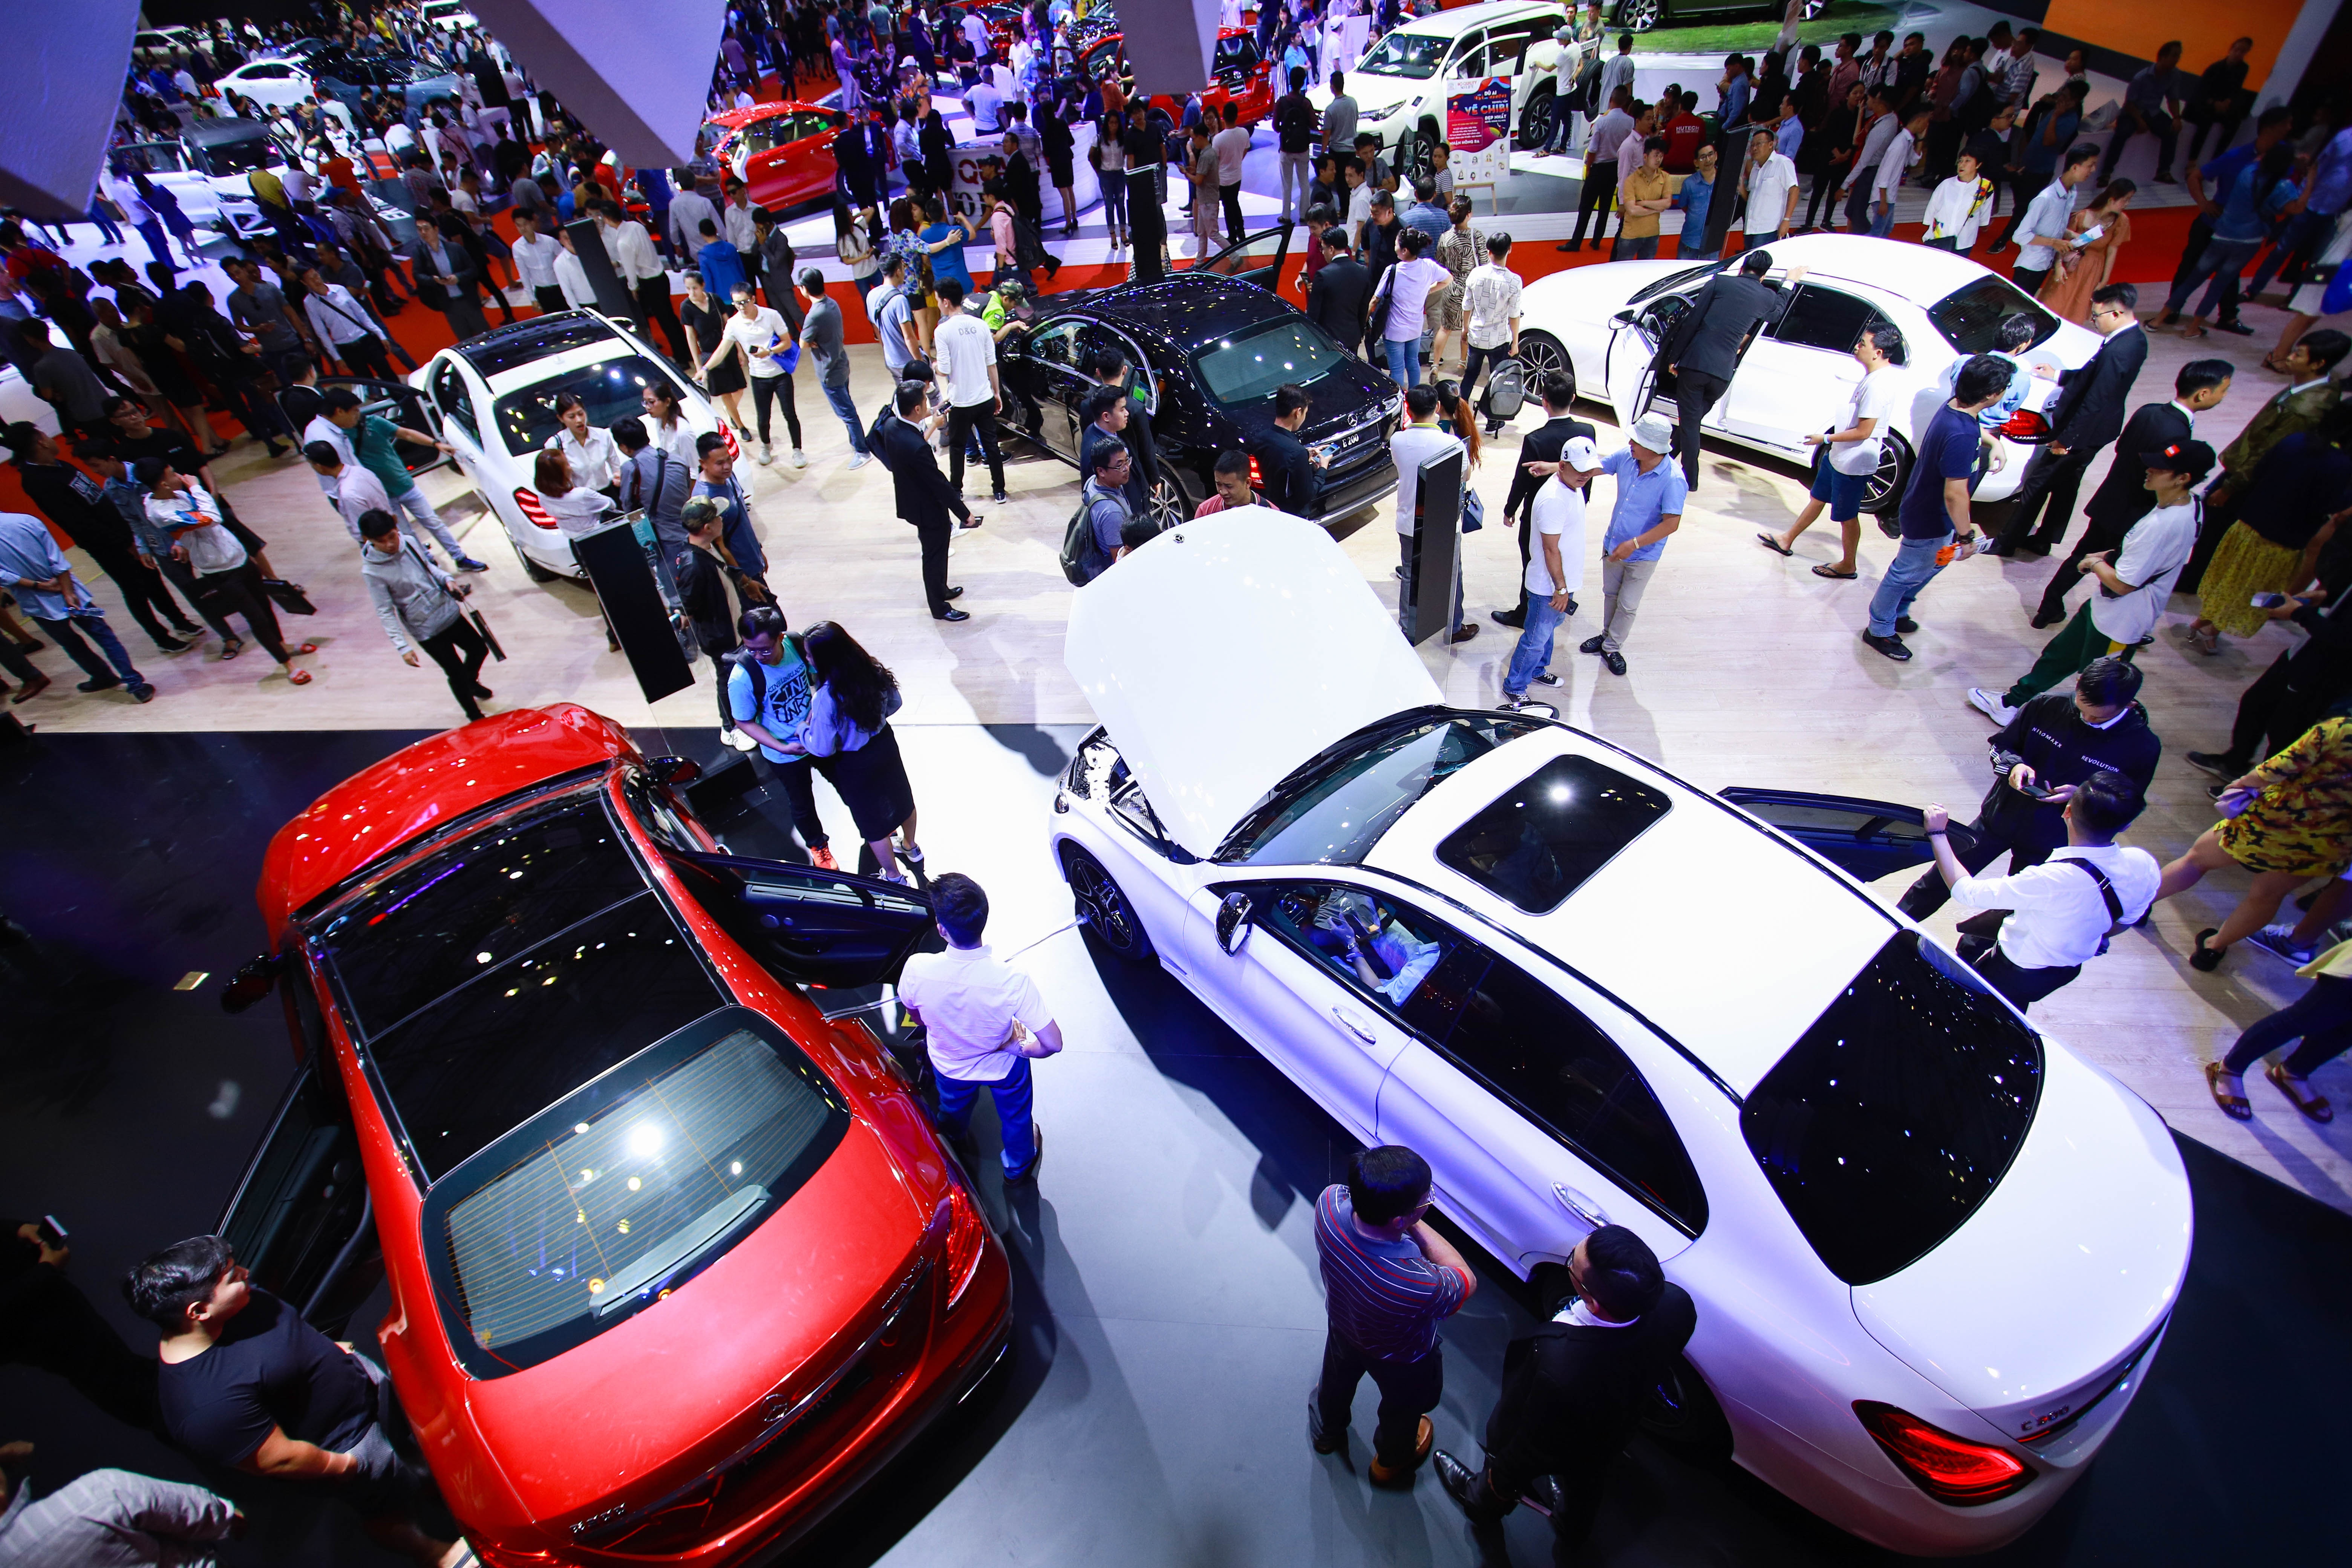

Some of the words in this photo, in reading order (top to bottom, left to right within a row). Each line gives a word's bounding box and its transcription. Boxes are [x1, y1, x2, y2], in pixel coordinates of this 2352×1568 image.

[1481, 103, 1509, 114] CHIBI
[958, 326, 977, 335] D&G
[1342, 439, 1348, 448] E
[1348, 433, 1359, 446] 200
[1564, 450, 1568, 459] 3
[2081, 755, 2119, 772] REVOLUTION
[2021, 1420, 2033, 1431] C
